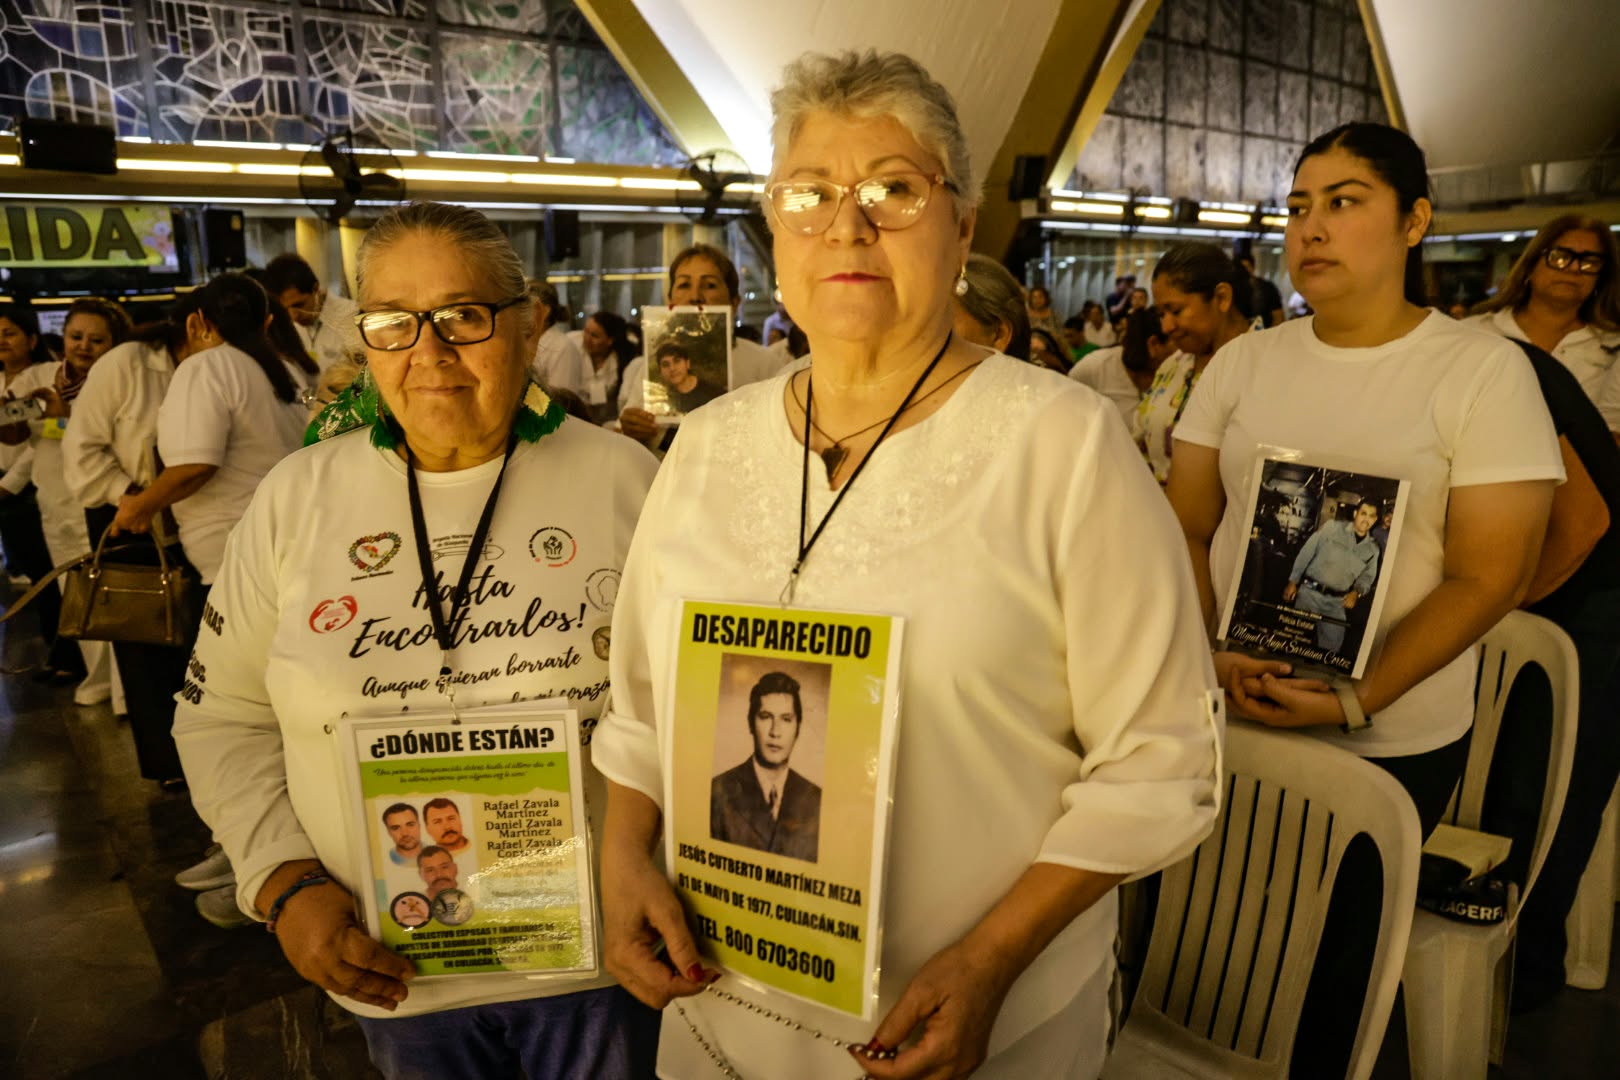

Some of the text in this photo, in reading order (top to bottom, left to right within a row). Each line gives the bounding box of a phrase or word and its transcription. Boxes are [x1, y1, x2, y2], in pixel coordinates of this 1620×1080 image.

[0, 205, 148, 261] IDA
[349, 597, 587, 658] Encotrarlos!
[692, 612, 872, 660] DESAPARECIDO
[361, 676, 430, 698] Aunque
[506, 646, 582, 676] borrarte
[560, 676, 611, 702] corazó
[370, 730, 463, 759] ¿DÓNDE
[470, 724, 555, 750] ESTÁN?
[484, 798, 560, 811] Rafael Zavala
[485, 817, 563, 831] Daniel Zavala
[487, 837, 563, 850] Rafael Zavala
[679, 843, 862, 906] JESÚS CUTBERTO MARTÍNEZ MEZA
[691, 877, 702, 893] DE
[704, 881, 730, 904] MAYO
[732, 891, 745, 909] DE
[747, 896, 773, 918] 1977,
[1440, 901, 1503, 921] LAGERF
[696, 914, 835, 983] TEL. 800 6703600
